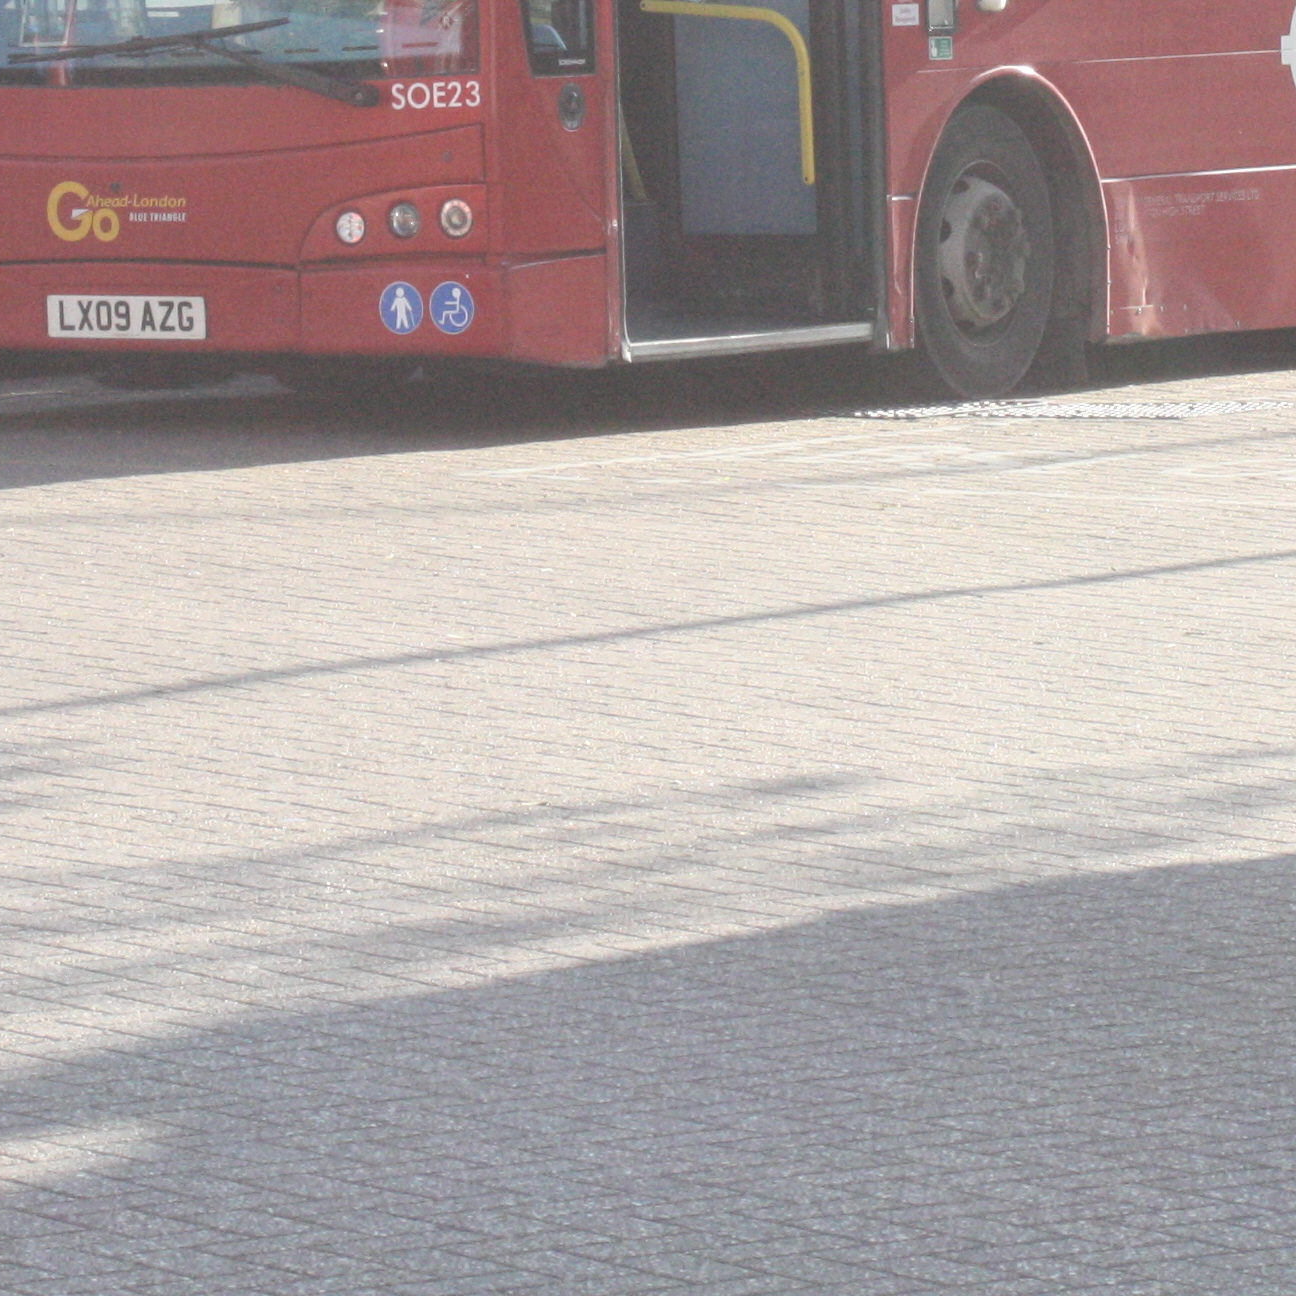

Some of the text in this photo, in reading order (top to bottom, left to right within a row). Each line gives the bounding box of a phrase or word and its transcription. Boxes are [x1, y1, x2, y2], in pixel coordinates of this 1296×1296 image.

[391, 80, 481, 110] SOE23
[47, 180, 120, 242] Go
[86, 193, 186, 208] Ahead-London
[58, 300, 195, 333] LX09 AZG
